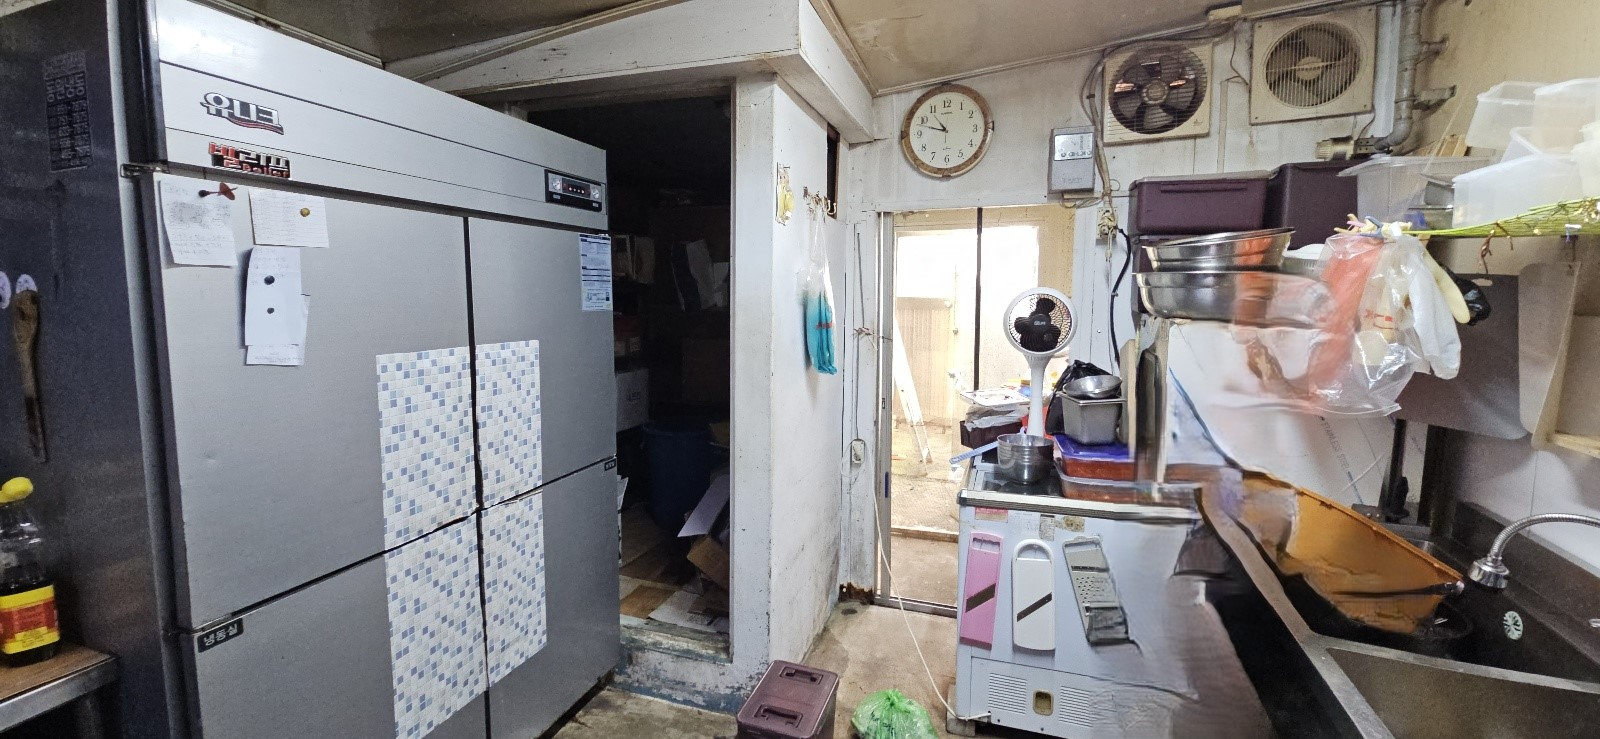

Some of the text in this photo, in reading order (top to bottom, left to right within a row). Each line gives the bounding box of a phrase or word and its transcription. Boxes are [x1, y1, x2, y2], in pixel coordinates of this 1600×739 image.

[942, 99, 952, 109] 12
[200, 92, 280, 127] 유니크
[929, 104, 937, 114] 11
[968, 110, 974, 119] 2
[920, 115, 929, 125] 10
[972, 124, 978, 133] 3
[916, 130, 923, 139] 9
[921, 143, 927, 152] 8
[967, 139, 974, 148] 4
[208, 142, 290, 170] 빌리프
[930, 151, 937, 161] 7
[957, 149, 964, 158] 5
[944, 154, 950, 163] 6
[203, 623, 238, 646] 냉동실
